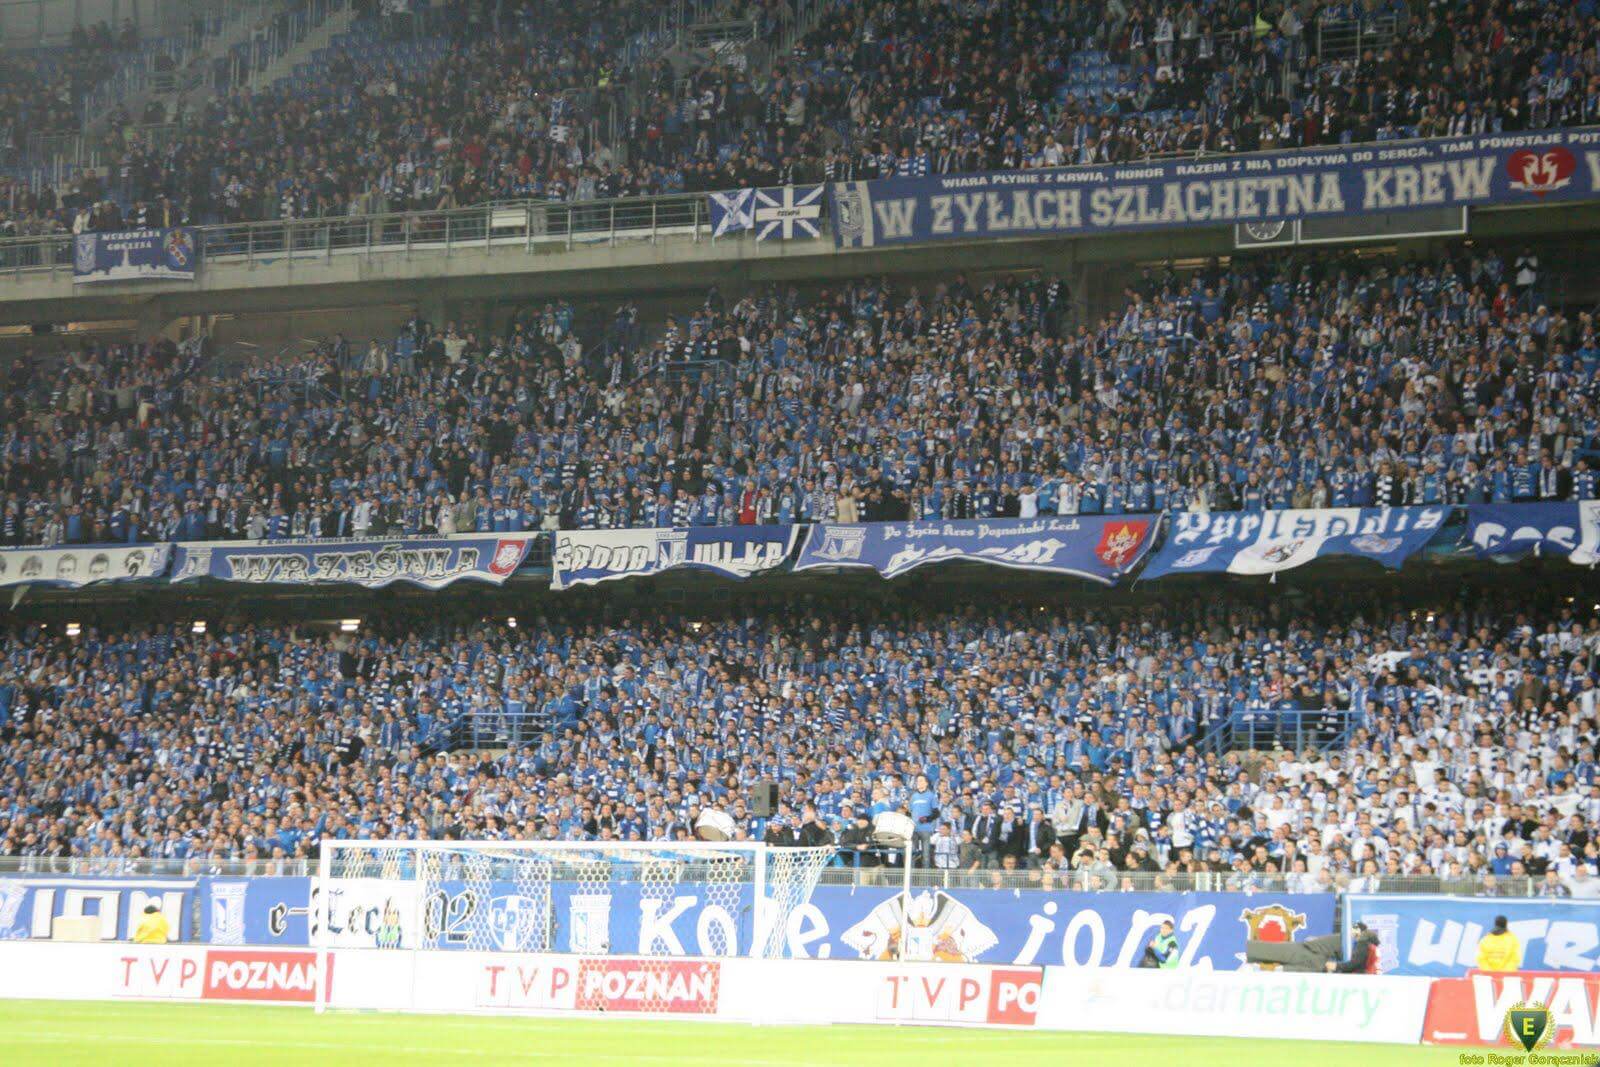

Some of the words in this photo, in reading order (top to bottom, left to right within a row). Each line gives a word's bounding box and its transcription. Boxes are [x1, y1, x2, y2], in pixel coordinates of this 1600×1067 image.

[942, 175, 987, 188] WIARA
[1043, 173, 1052, 183] Z
[1115, 168, 1164, 180] HONOR
[1176, 162, 1226, 175] RAZEM
[1232, 160, 1241, 170] Z
[1352, 151, 1373, 163] DO
[1439, 140, 1474, 154] TAM
[1479, 133, 1563, 148] POWSTAJE
[875, 198, 917, 239] W
[1090, 171, 1345, 226] SZLACHETNA
[1363, 155, 1497, 209] KREW
[226, 544, 480, 580] WRZEŚNIA
[584, 964, 712, 1001] POZNAŃ
